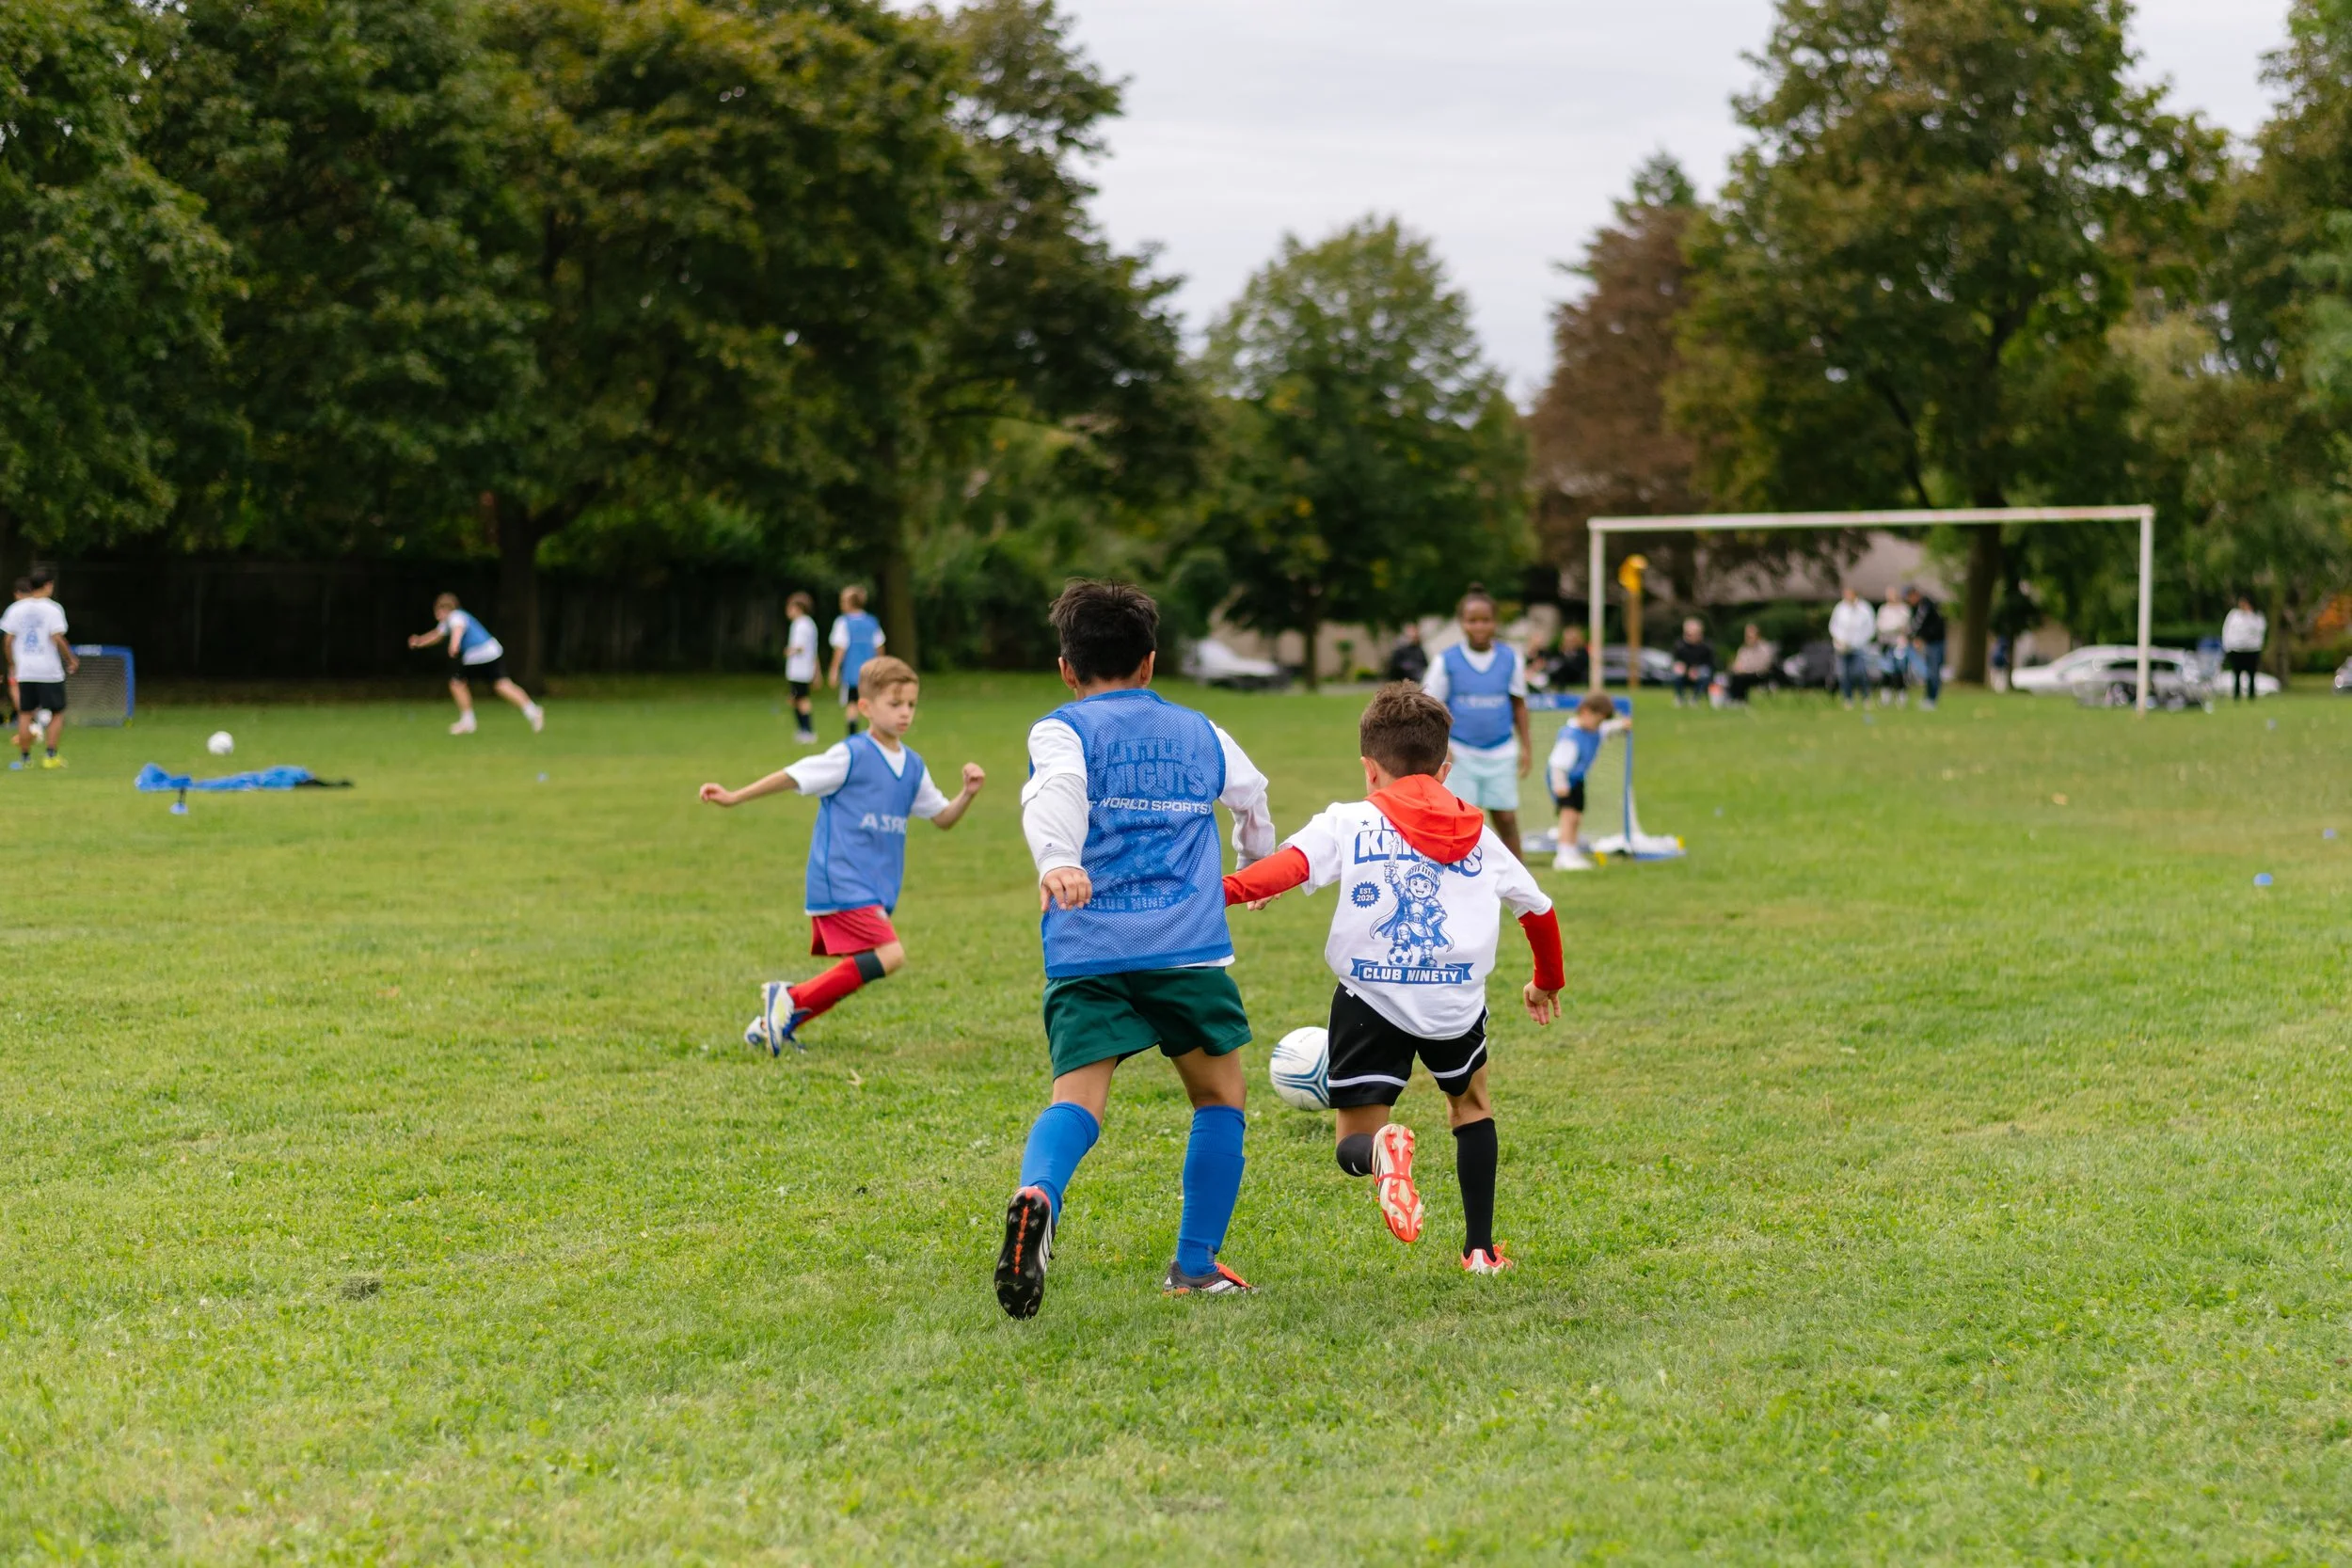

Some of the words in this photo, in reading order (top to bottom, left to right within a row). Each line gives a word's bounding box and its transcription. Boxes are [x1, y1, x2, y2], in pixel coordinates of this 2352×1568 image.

[1152, 800, 1210, 816] SPORTS
[1355, 830, 1483, 878] KNIS
[1362, 967, 1403, 981] CLUB
[1406, 969, 1459, 982] NINETY
